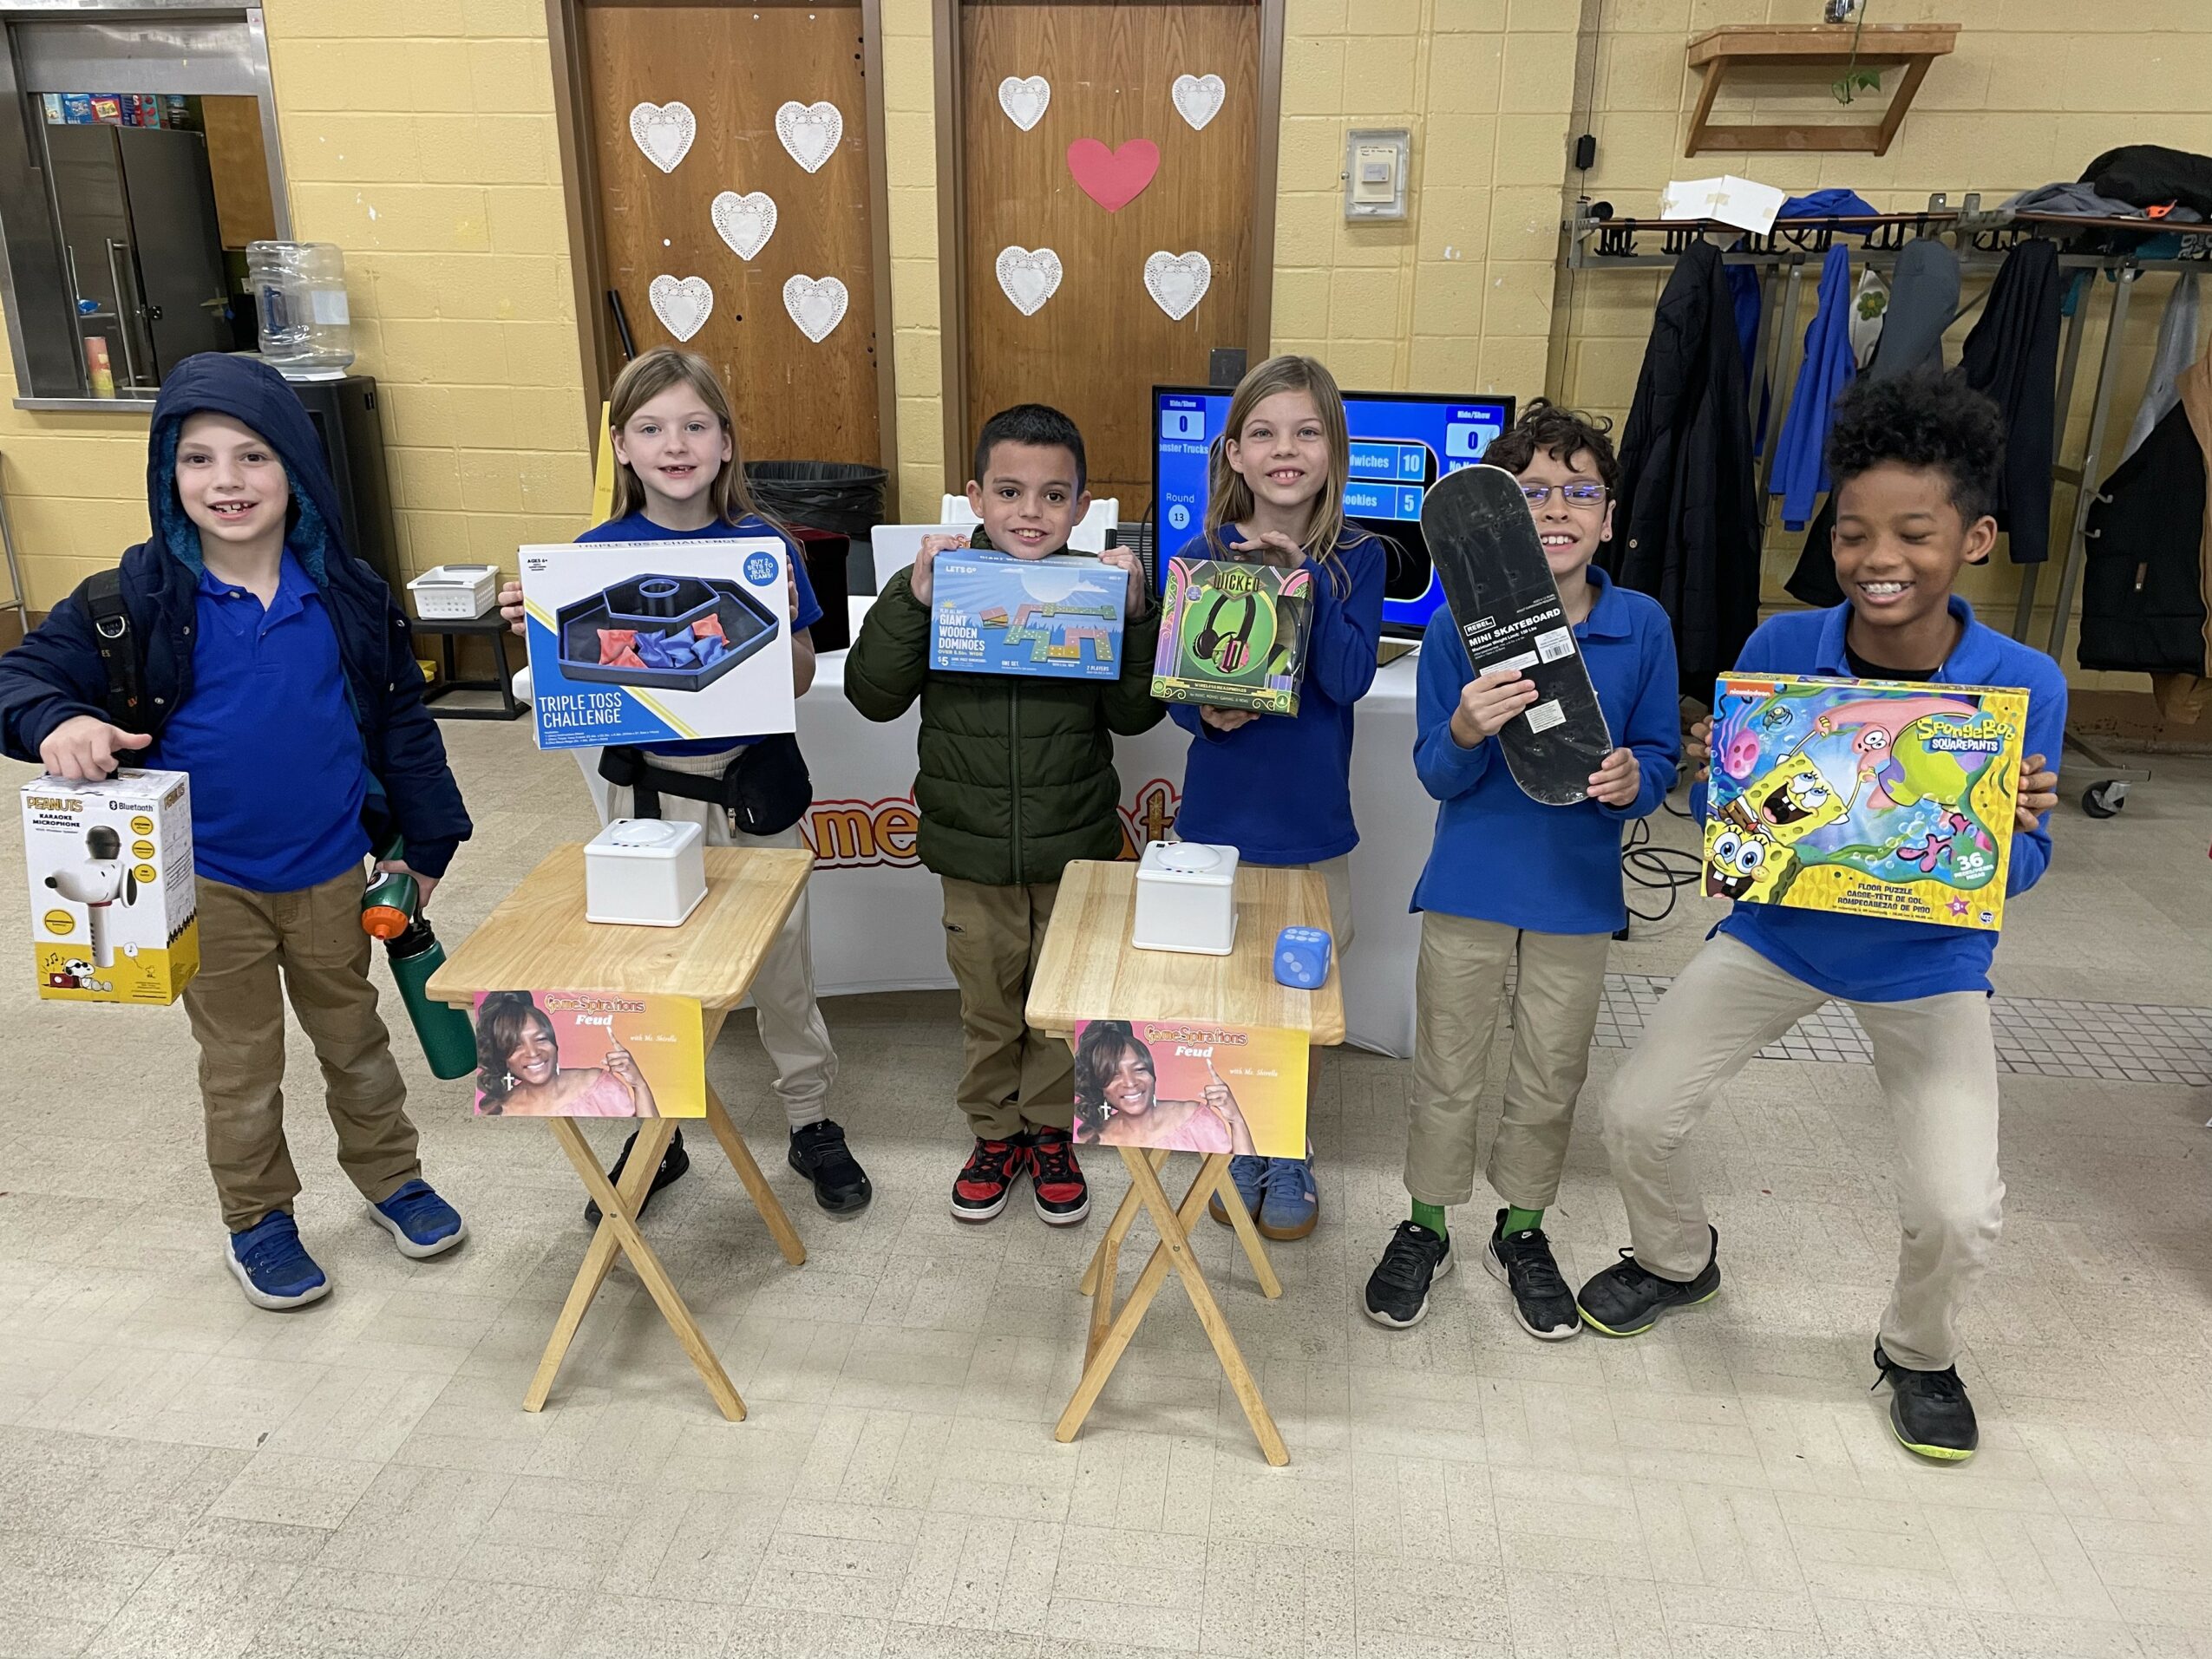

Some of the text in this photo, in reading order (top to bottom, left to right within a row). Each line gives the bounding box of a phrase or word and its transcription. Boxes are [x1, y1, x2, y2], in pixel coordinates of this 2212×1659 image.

[1457, 410, 1490, 419] Hide/Show
[1180, 415, 1188, 432] 0
[1468, 432, 1478, 449] 0
[1183, 444, 1208, 454] Trucks
[1403, 454, 1420, 472] 10
[1166, 493, 1194, 503] Round
[1342, 494, 1415, 513] ookies 5
[1175, 513, 1184, 522] 13
[1214, 572, 1260, 591] WICKED
[939, 614, 966, 626] GIANT
[1469, 608, 1561, 647] MINI SKATEBOARD
[939, 625, 978, 639] WOODEN
[939, 637, 985, 651] DOMINOES
[1471, 643, 1492, 652] Maximum
[938, 656, 949, 666] $5
[539, 692, 622, 712] TRIPLE TOSS
[543, 709, 622, 728] CHALLENGE
[1916, 718, 2016, 741] SpongeBob
[1932, 738, 1999, 752] SQUAREPANTS
[27, 795, 83, 813] PEANUTS
[119, 802, 154, 812] Bluetooth
[1956, 852, 1985, 871] 36
[1858, 883, 1913, 895] FLOOR PUZZLE
[1837, 897, 1897, 910] ROMPECABEZAS
[1913, 905, 1930, 914] PISO
[544, 994, 646, 1016] GameSpirations
[575, 1014, 613, 1026] Feud
[1143, 1024, 1248, 1047] GameSpirations
[1175, 1046, 1214, 1058] Feud
